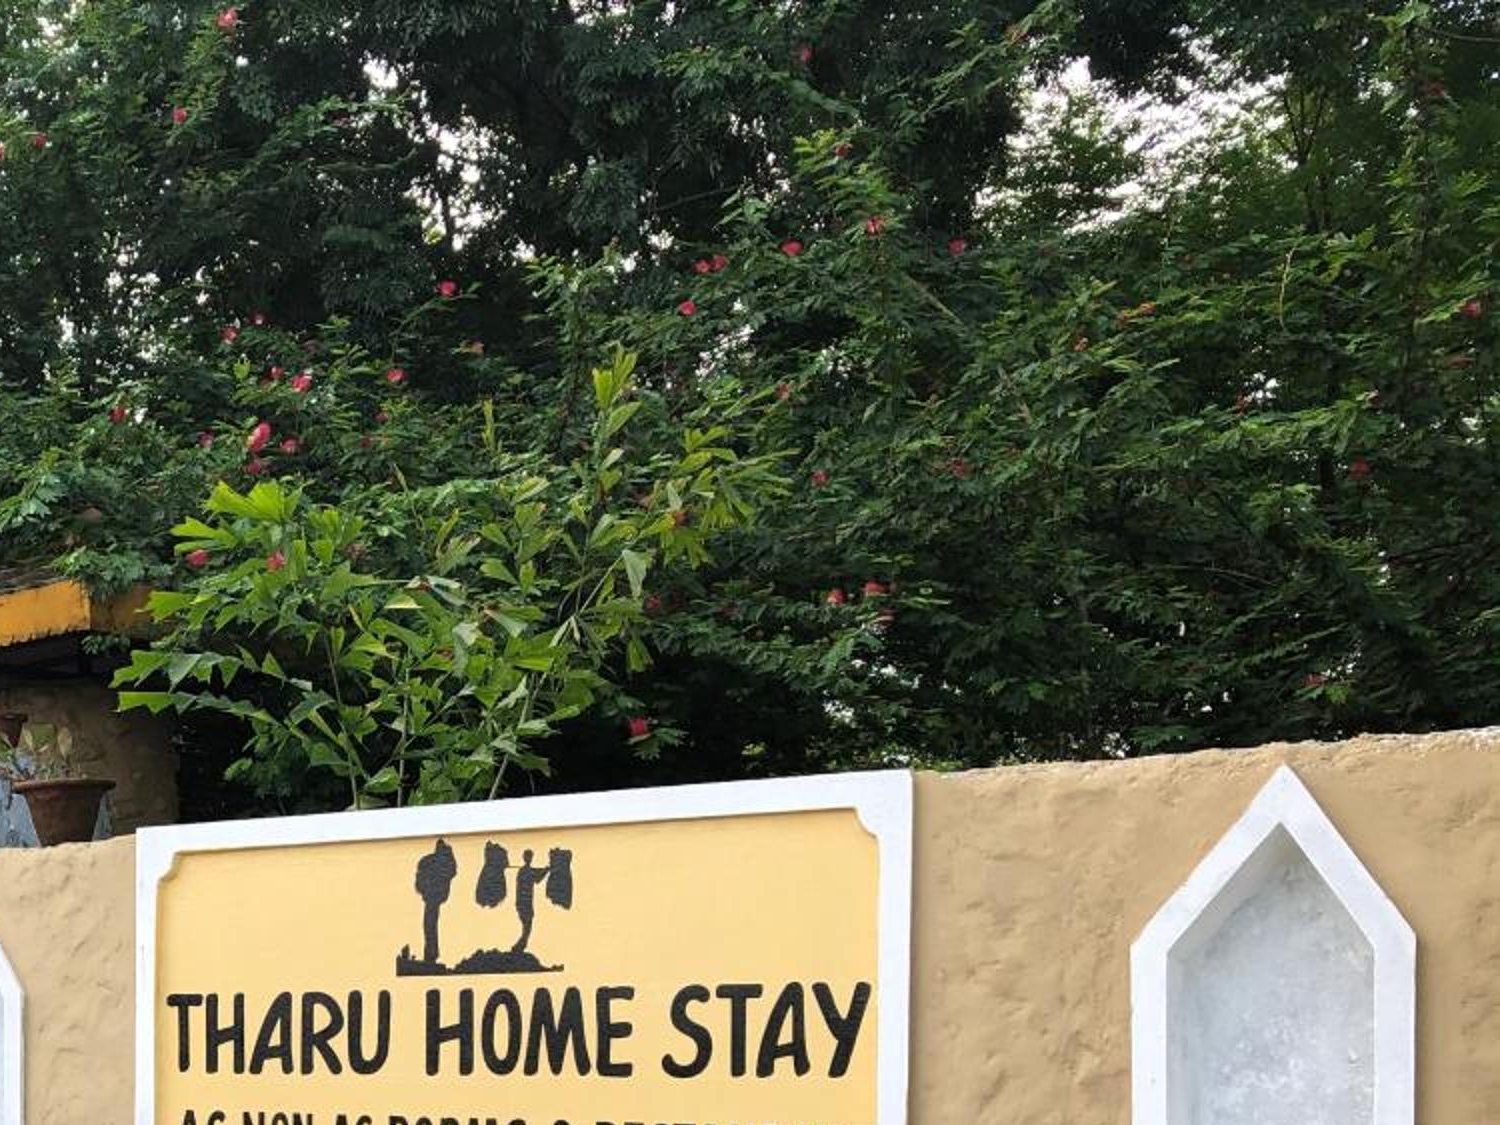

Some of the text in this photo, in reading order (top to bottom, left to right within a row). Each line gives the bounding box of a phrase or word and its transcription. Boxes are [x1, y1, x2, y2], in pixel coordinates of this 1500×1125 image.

[165, 980, 873, 1080] THARU HOME STAY
